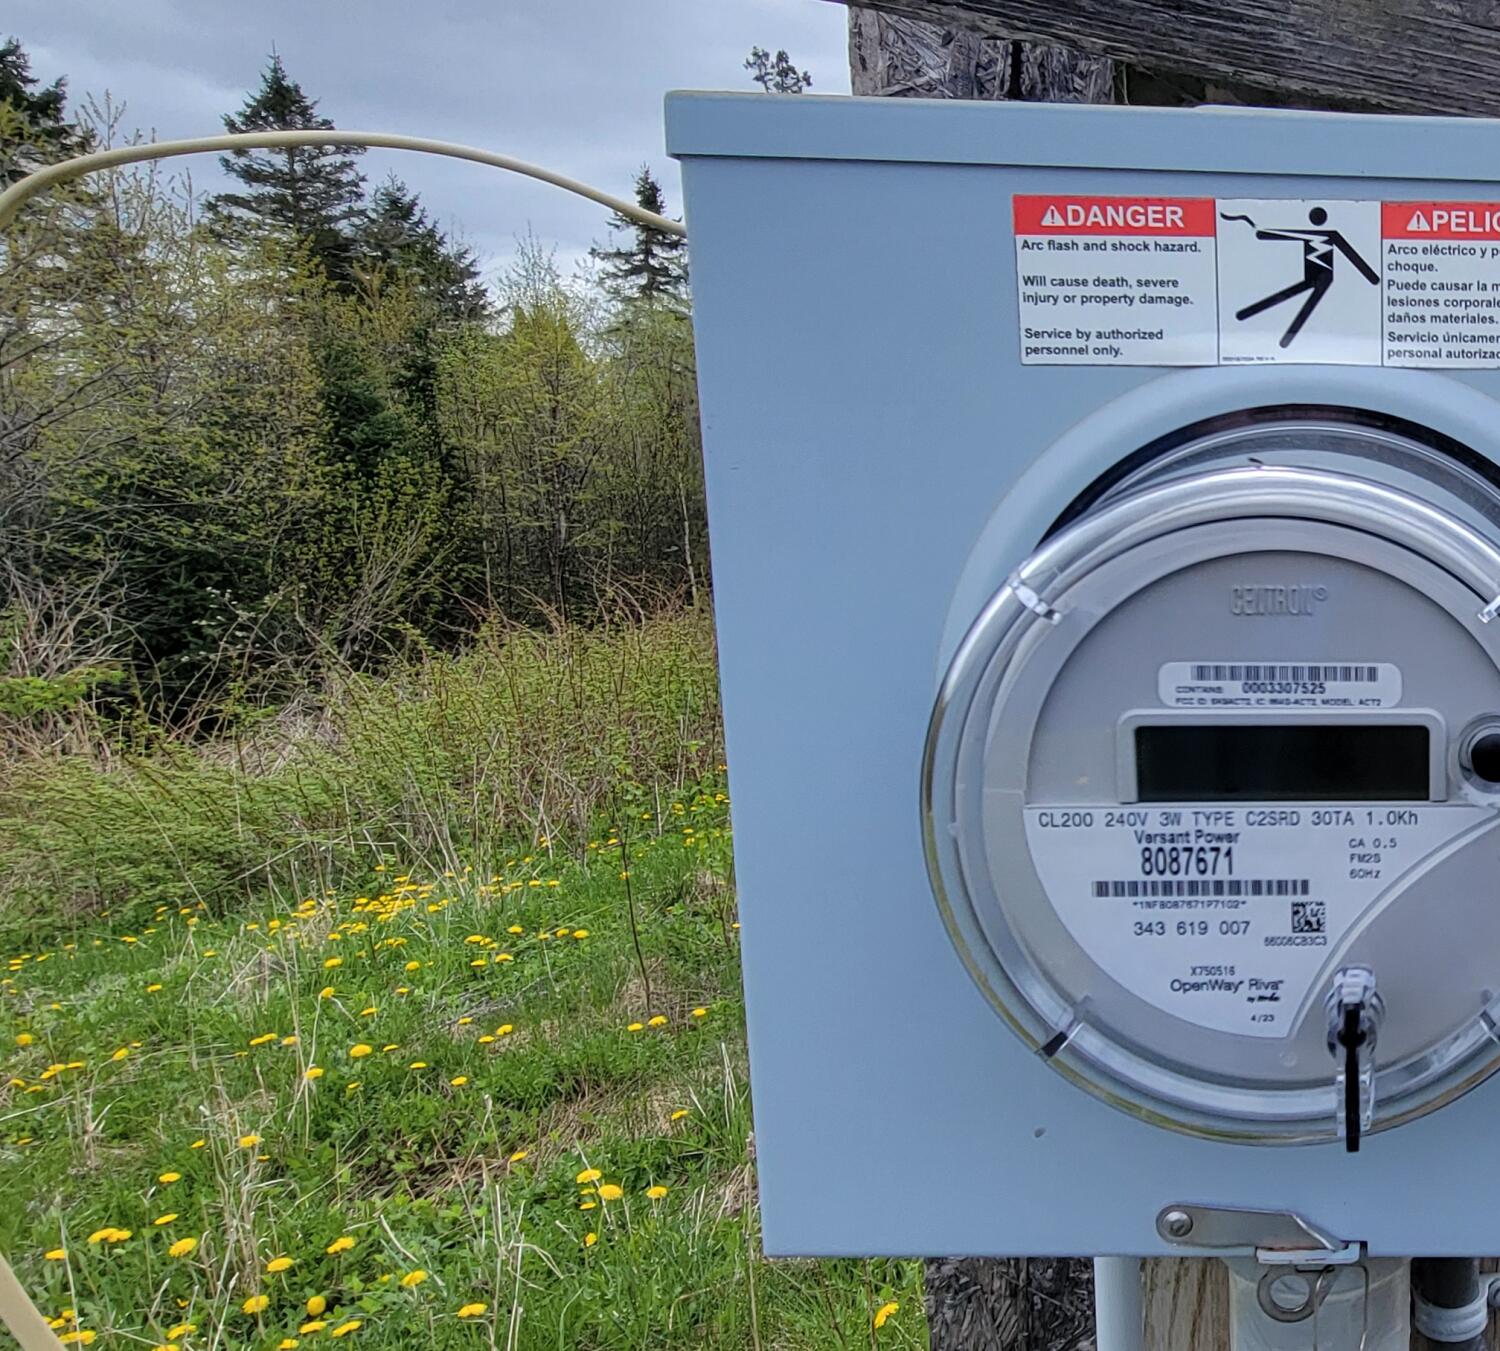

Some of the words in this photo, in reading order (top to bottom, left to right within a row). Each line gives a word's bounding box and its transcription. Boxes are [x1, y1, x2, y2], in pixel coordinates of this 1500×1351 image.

[1066, 205, 1185, 228] DANGER
[1021, 239, 1044, 251] Arc
[1047, 239, 1079, 251] flash
[1083, 240, 1107, 252] and
[1111, 240, 1150, 252] shock
[1154, 241, 1201, 253] hazard.
[1387, 244, 1418, 256] Arco
[1422, 244, 1476, 257] eléctrico
[1480, 247, 1487, 259] y
[1387, 261, 1438, 273] choque.
[1022, 275, 1046, 287] Will
[1051, 278, 1088, 288] cause
[1093, 276, 1133, 289] death,
[1136, 279, 1179, 288] severe
[1387, 279, 1427, 291] Puede
[1431, 282, 1473, 292] causar
[1477, 281, 1487, 292] la
[1022, 293, 1059, 306] injury
[1063, 295, 1077, 304] or
[1081, 294, 1135, 306] property
[1139, 294, 1194, 307] damage.
[1387, 296, 1440, 308] lesiones
[1387, 312, 1426, 324] daños
[1430, 313, 1499, 325] materiales.
[1024, 328, 1072, 340] Service
[1076, 328, 1091, 342] by
[1095, 329, 1163, 340] authorized
[1387, 331, 1439, 343] Servicio
[1025, 344, 1089, 357] personnel
[1093, 345, 1123, 358] only.
[1387, 348, 1442, 361] personal
[1241, 682, 1326, 694] 0003307525
[1038, 812, 1094, 828] CL200
[1104, 812, 1149, 827] 240V
[1159, 812, 1182, 827] 3W
[1192, 811, 1235, 826] TYPE
[1246, 811, 1300, 827] C2SRD
[1311, 810, 1355, 826] 30TA
[1366, 810, 1418, 826] 1.0Kh
[1134, 830, 1191, 844] Versant
[1194, 830, 1241, 845] Power
[1348, 838, 1365, 849] CA
[1372, 837, 1397, 849] 0.5
[1141, 846, 1234, 876] 8087671
[1349, 853, 1382, 864] FM2S
[1349, 868, 1381, 879] 60Hz
[1133, 921, 1166, 936] 343
[1176, 920, 1208, 936] 619
[1219, 920, 1251, 936] 007
